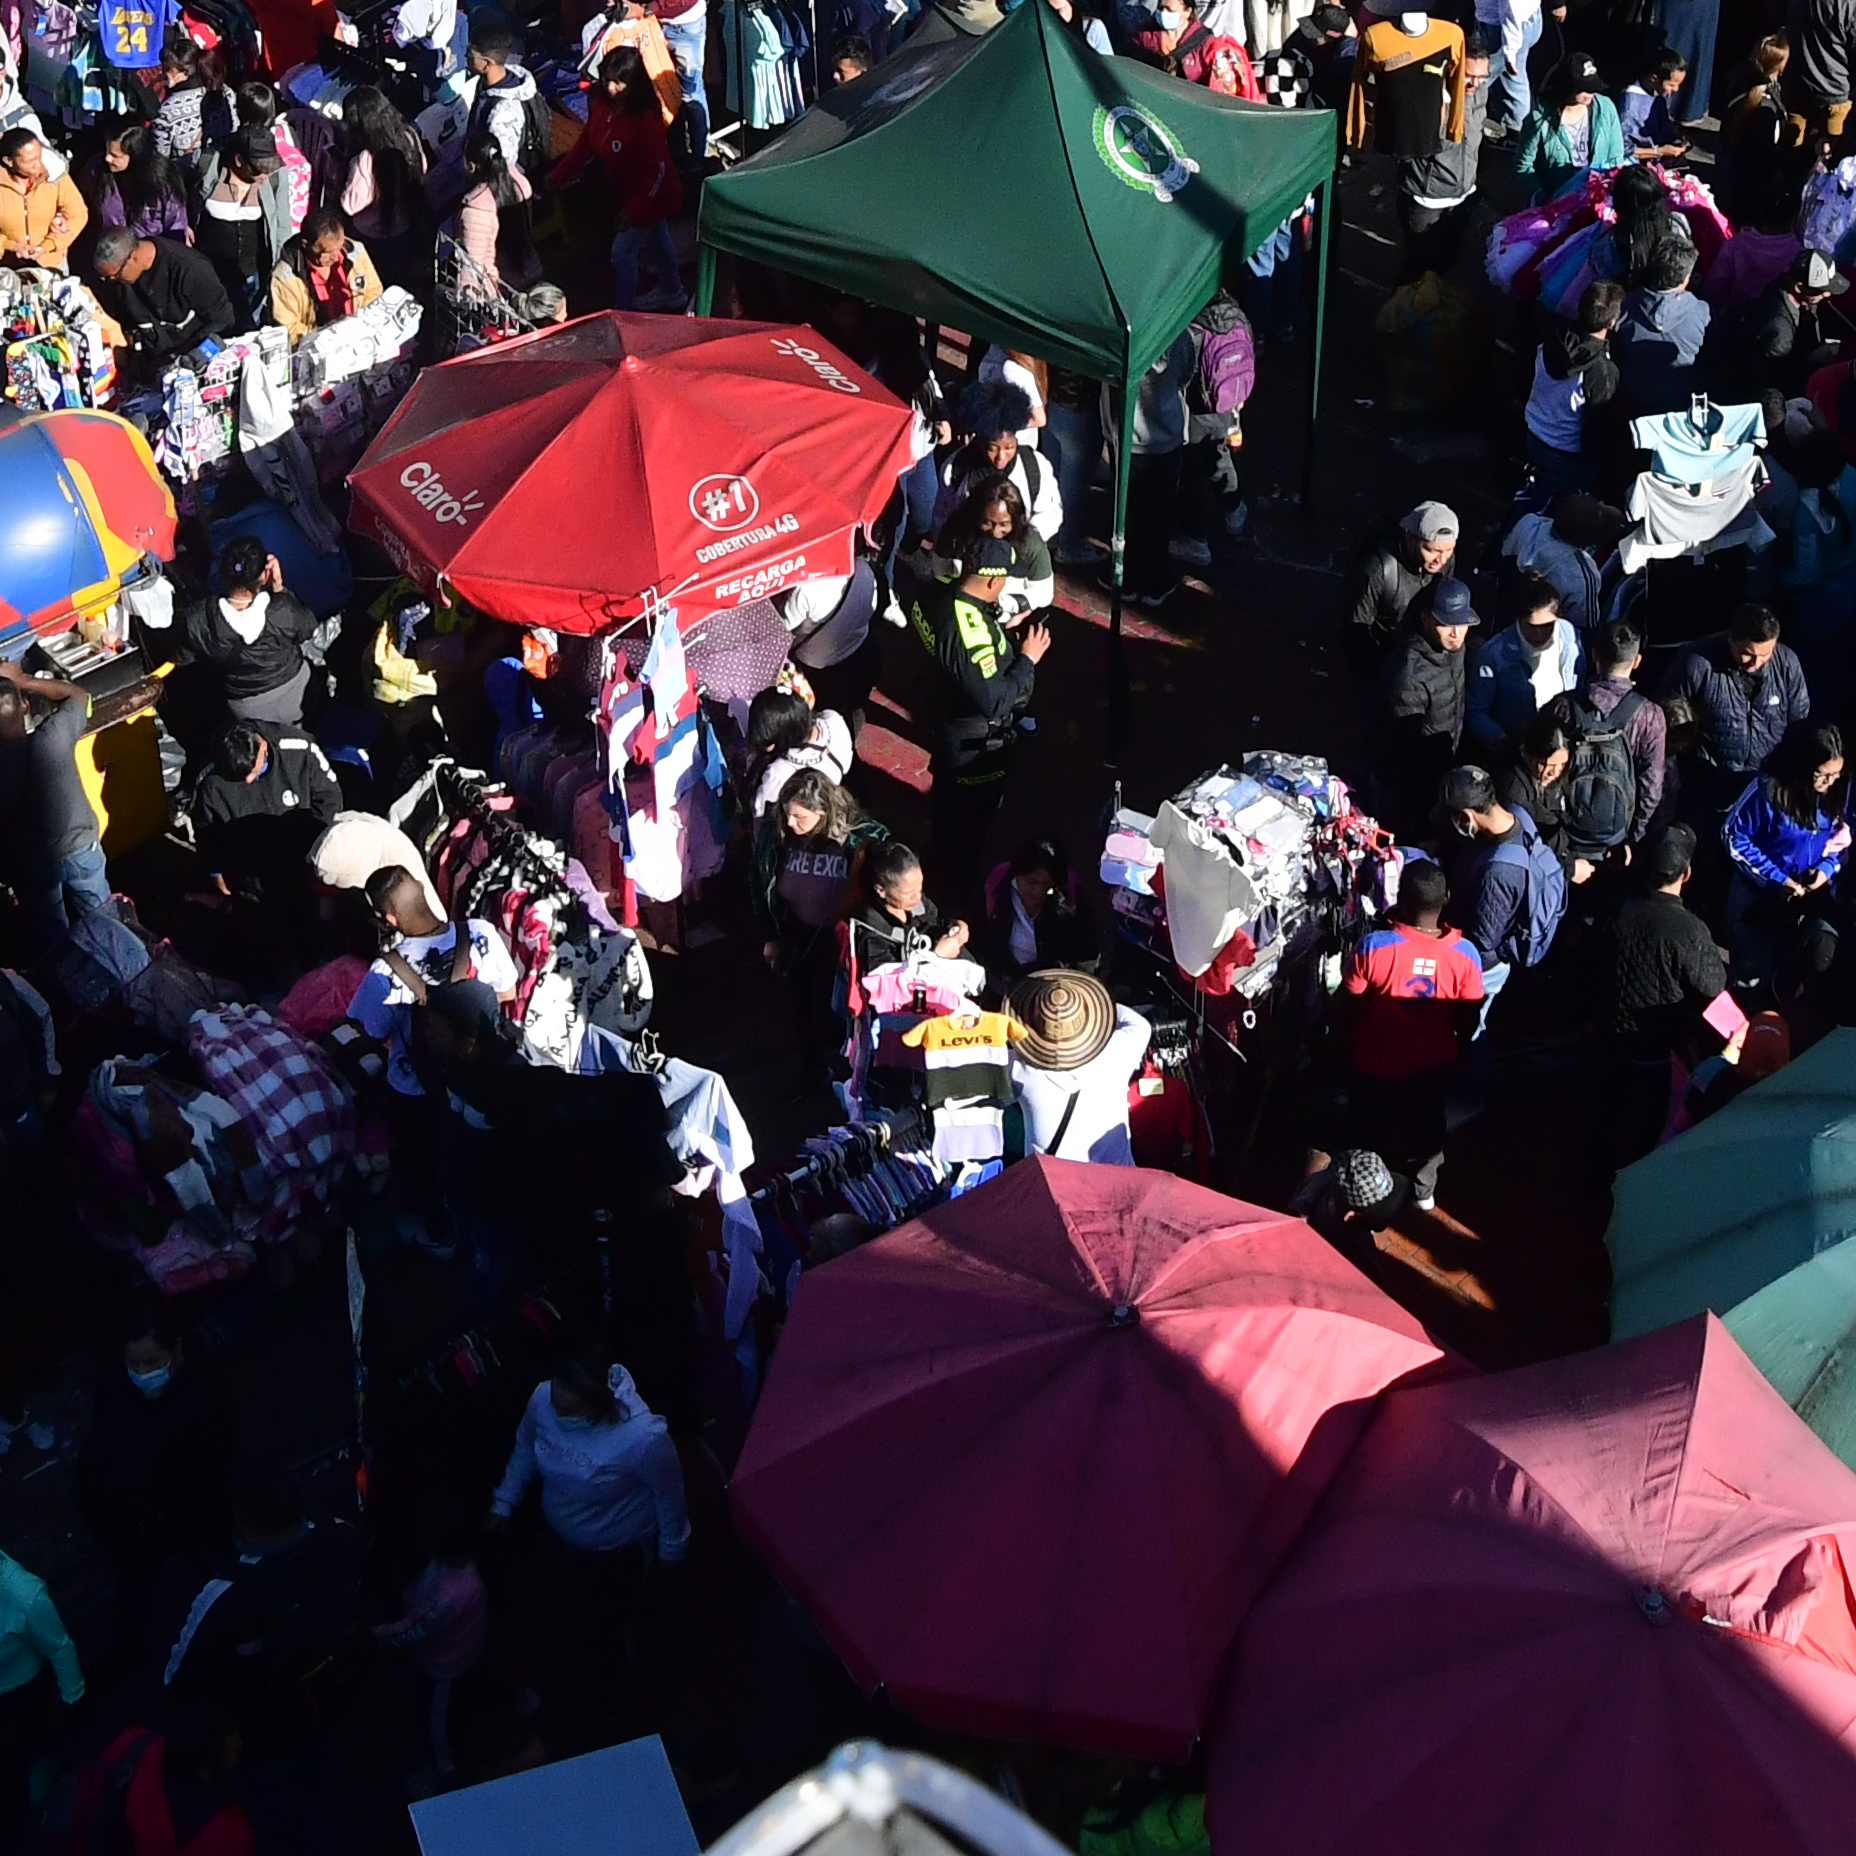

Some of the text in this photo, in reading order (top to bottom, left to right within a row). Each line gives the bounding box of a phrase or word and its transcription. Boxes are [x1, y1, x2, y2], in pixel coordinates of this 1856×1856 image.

[115, 26, 150, 53] 24
[793, 346, 862, 394] Claro
[399, 461, 464, 524] Claro
[701, 479, 748, 523] #1
[696, 512, 801, 564] COBERTURA 4G
[715, 555, 808, 600] RECARGA
